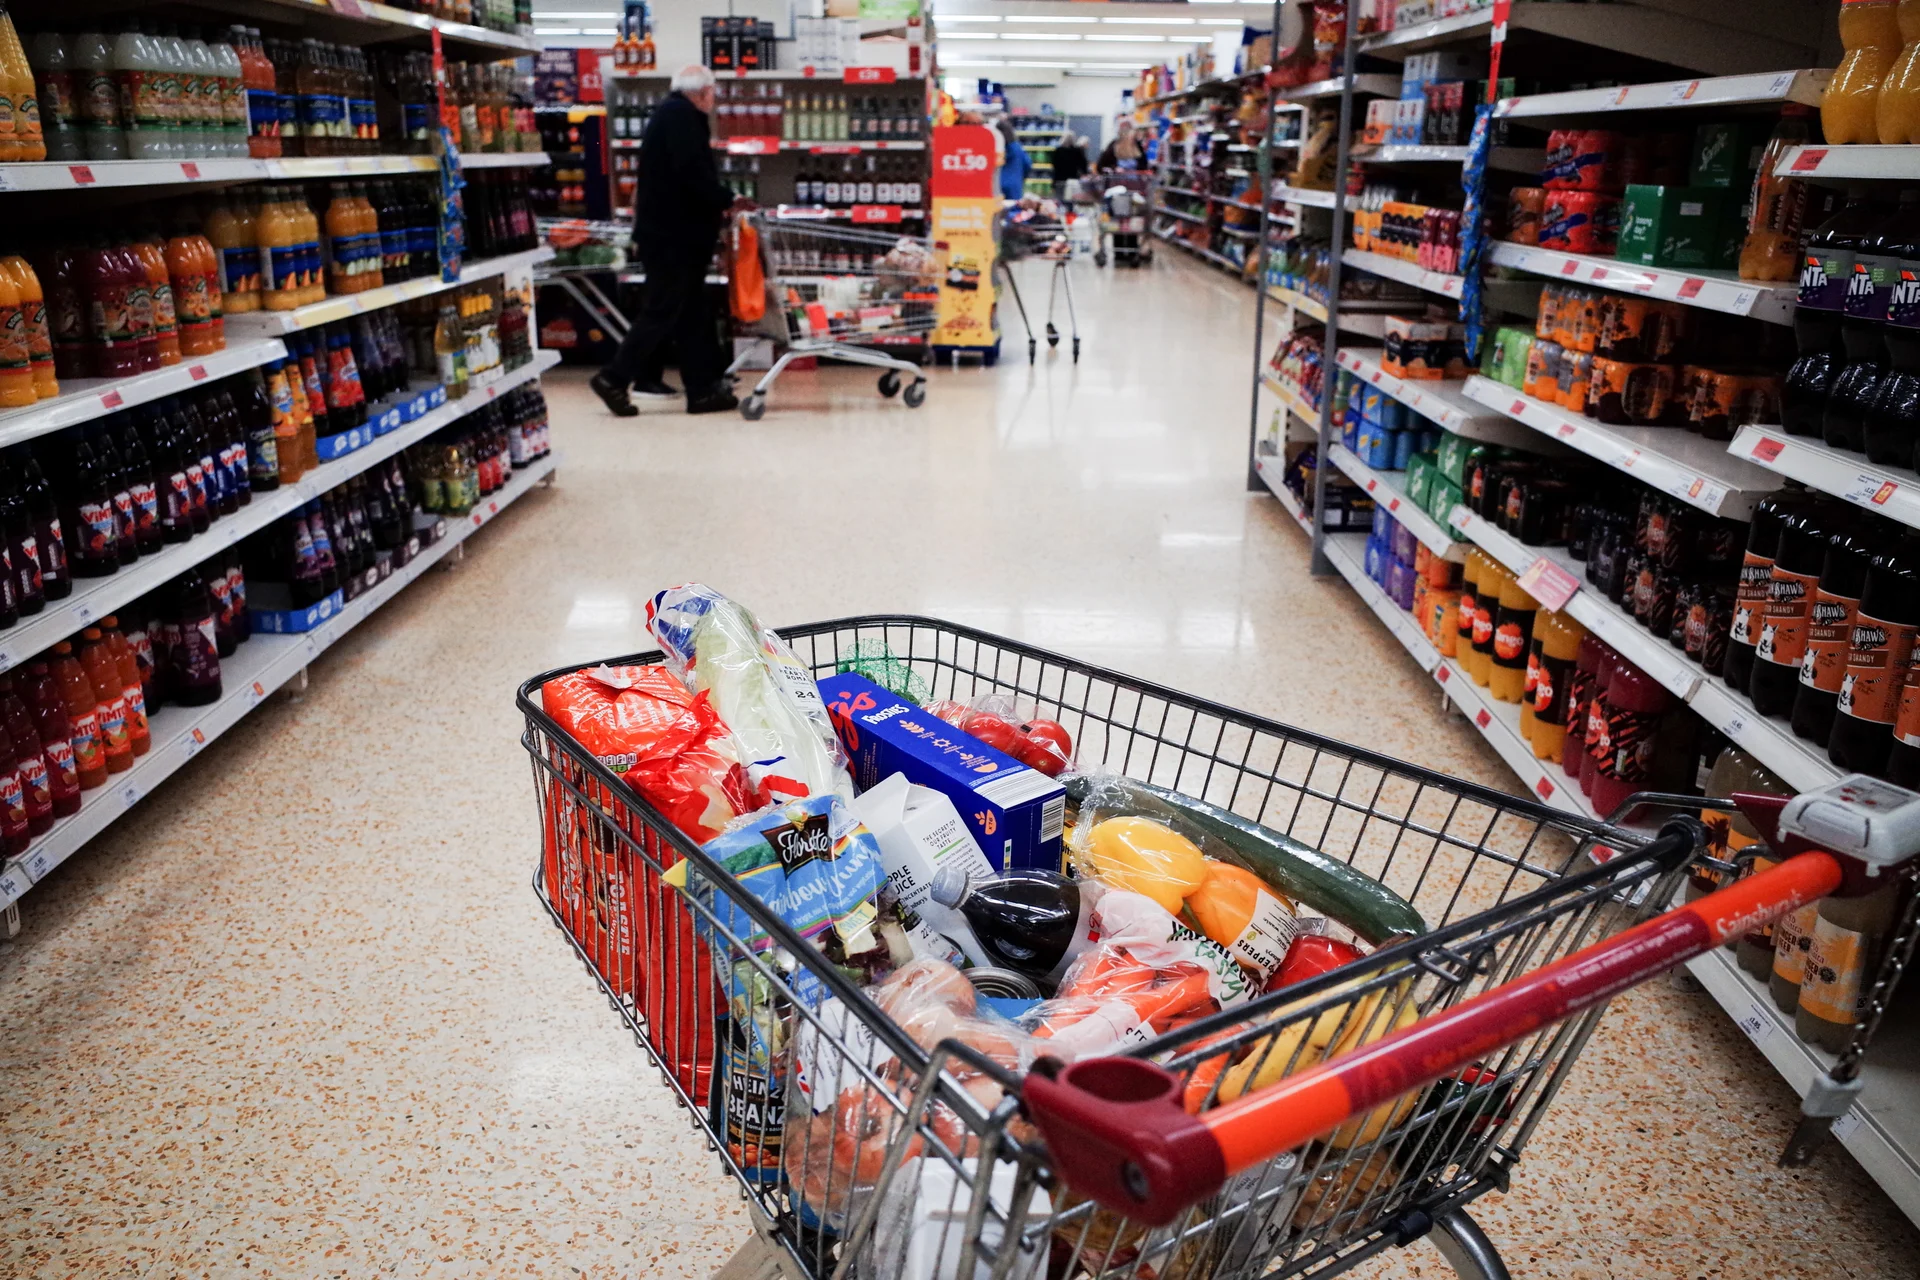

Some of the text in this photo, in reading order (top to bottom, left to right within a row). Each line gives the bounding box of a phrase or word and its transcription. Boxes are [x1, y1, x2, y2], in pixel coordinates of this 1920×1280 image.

[1801, 266, 1828, 287] NTA
[1849, 274, 1873, 295] NTA
[1892, 281, 1920, 304] NTA
[861, 703, 910, 725] FROSTIES
[922, 834, 933, 843] THE
[932, 823, 950, 837] SECRET
[929, 827, 957, 847] OUR FRUITY
[778, 828, 828, 864] Florette
[768, 876, 829, 916] ainbow
